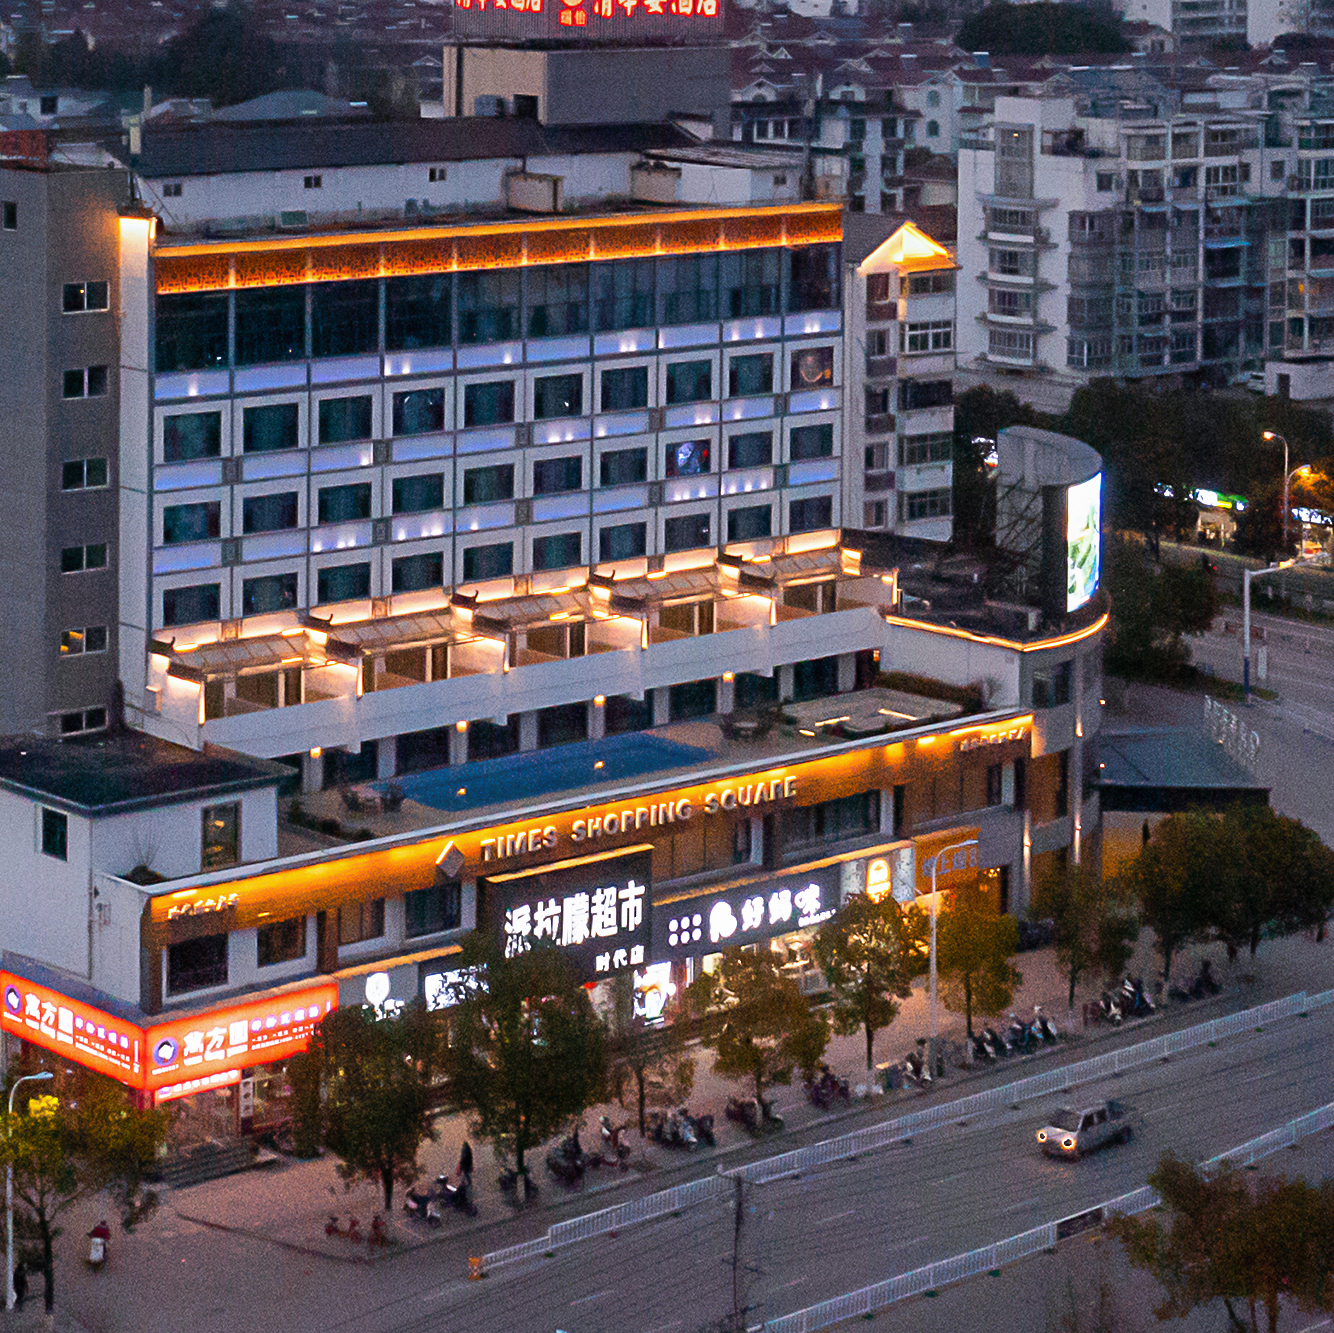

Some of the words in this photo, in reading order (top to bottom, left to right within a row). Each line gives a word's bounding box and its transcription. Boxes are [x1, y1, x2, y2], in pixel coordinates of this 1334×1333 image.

[480, 825, 557, 862] TIMES
[570, 798, 692, 842] SHOPPING
[703, 775, 798, 814] SQUARE
[595, 944, 645, 973] 时代店
